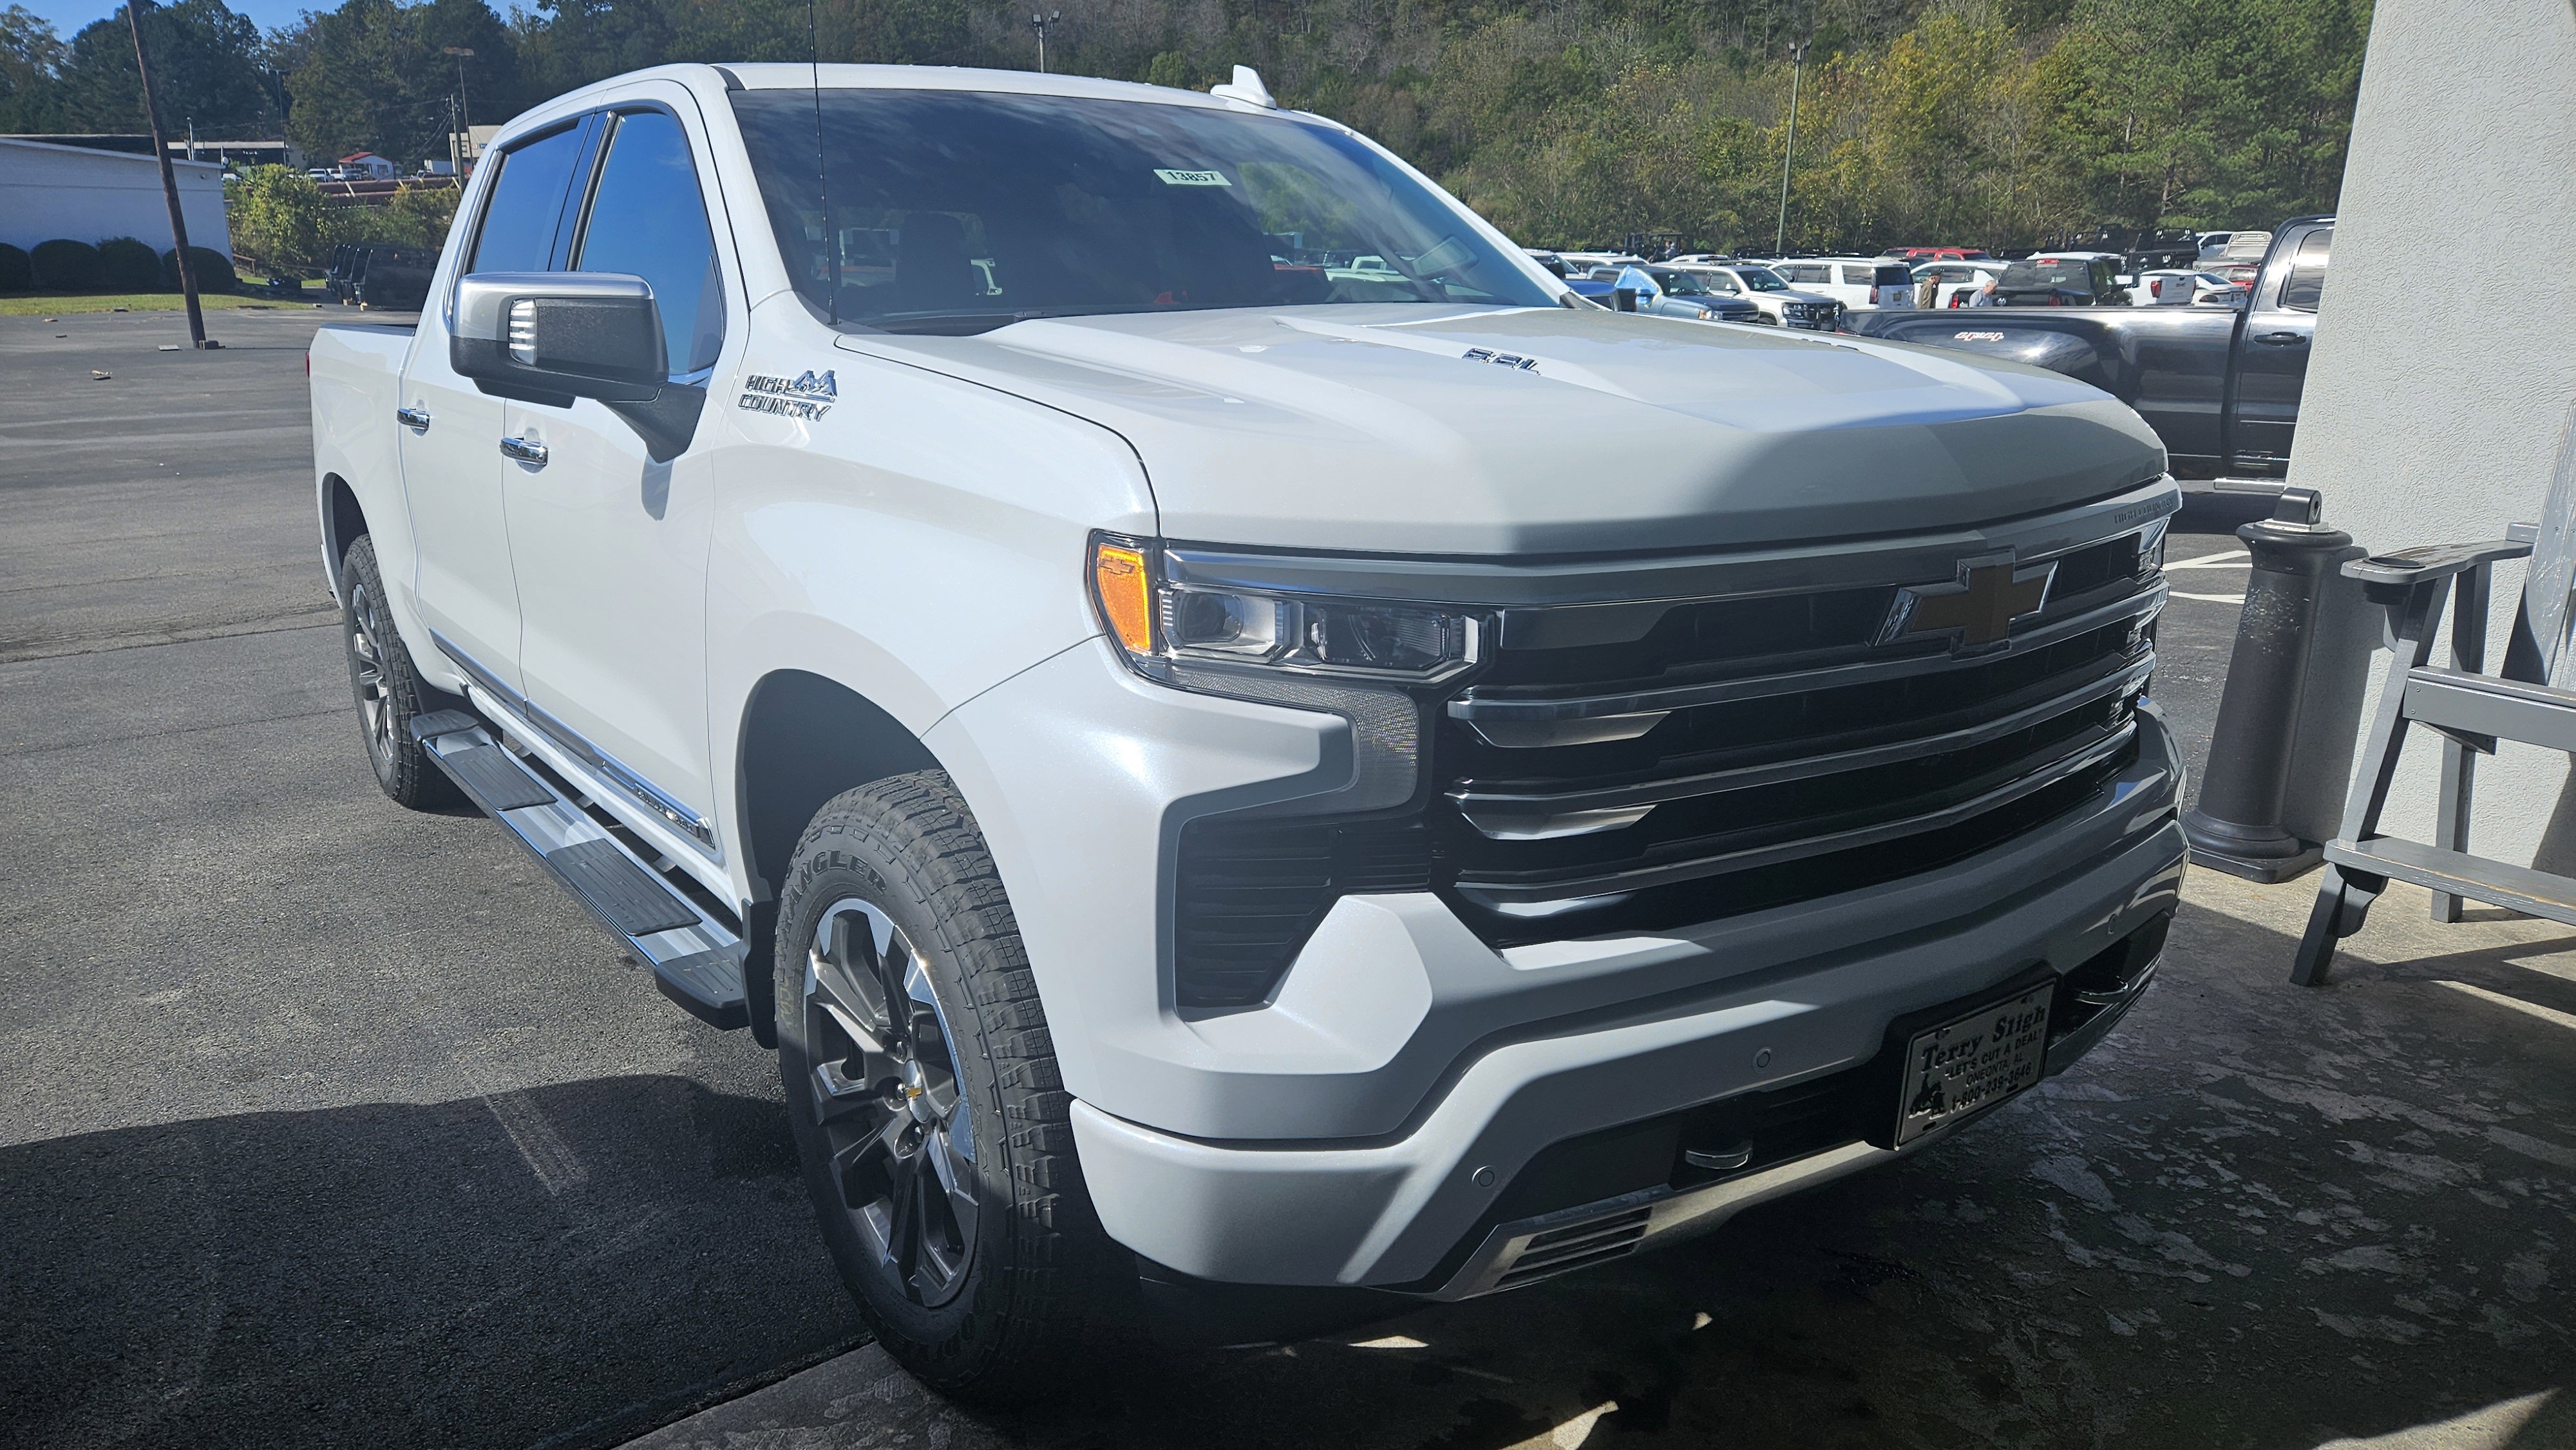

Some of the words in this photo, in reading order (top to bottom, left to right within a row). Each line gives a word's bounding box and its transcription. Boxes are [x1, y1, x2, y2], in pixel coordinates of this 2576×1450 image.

[1166, 171, 1216, 181] 13857
[745, 375, 791, 395] HIGH
[738, 393, 831, 422] COUNTRY
[1921, 1034, 1984, 1072] Terry
[1981, 1048, 2000, 1064] CUT
[2003, 1042, 2011, 1056] A
[2014, 1053, 2023, 1064] AL
